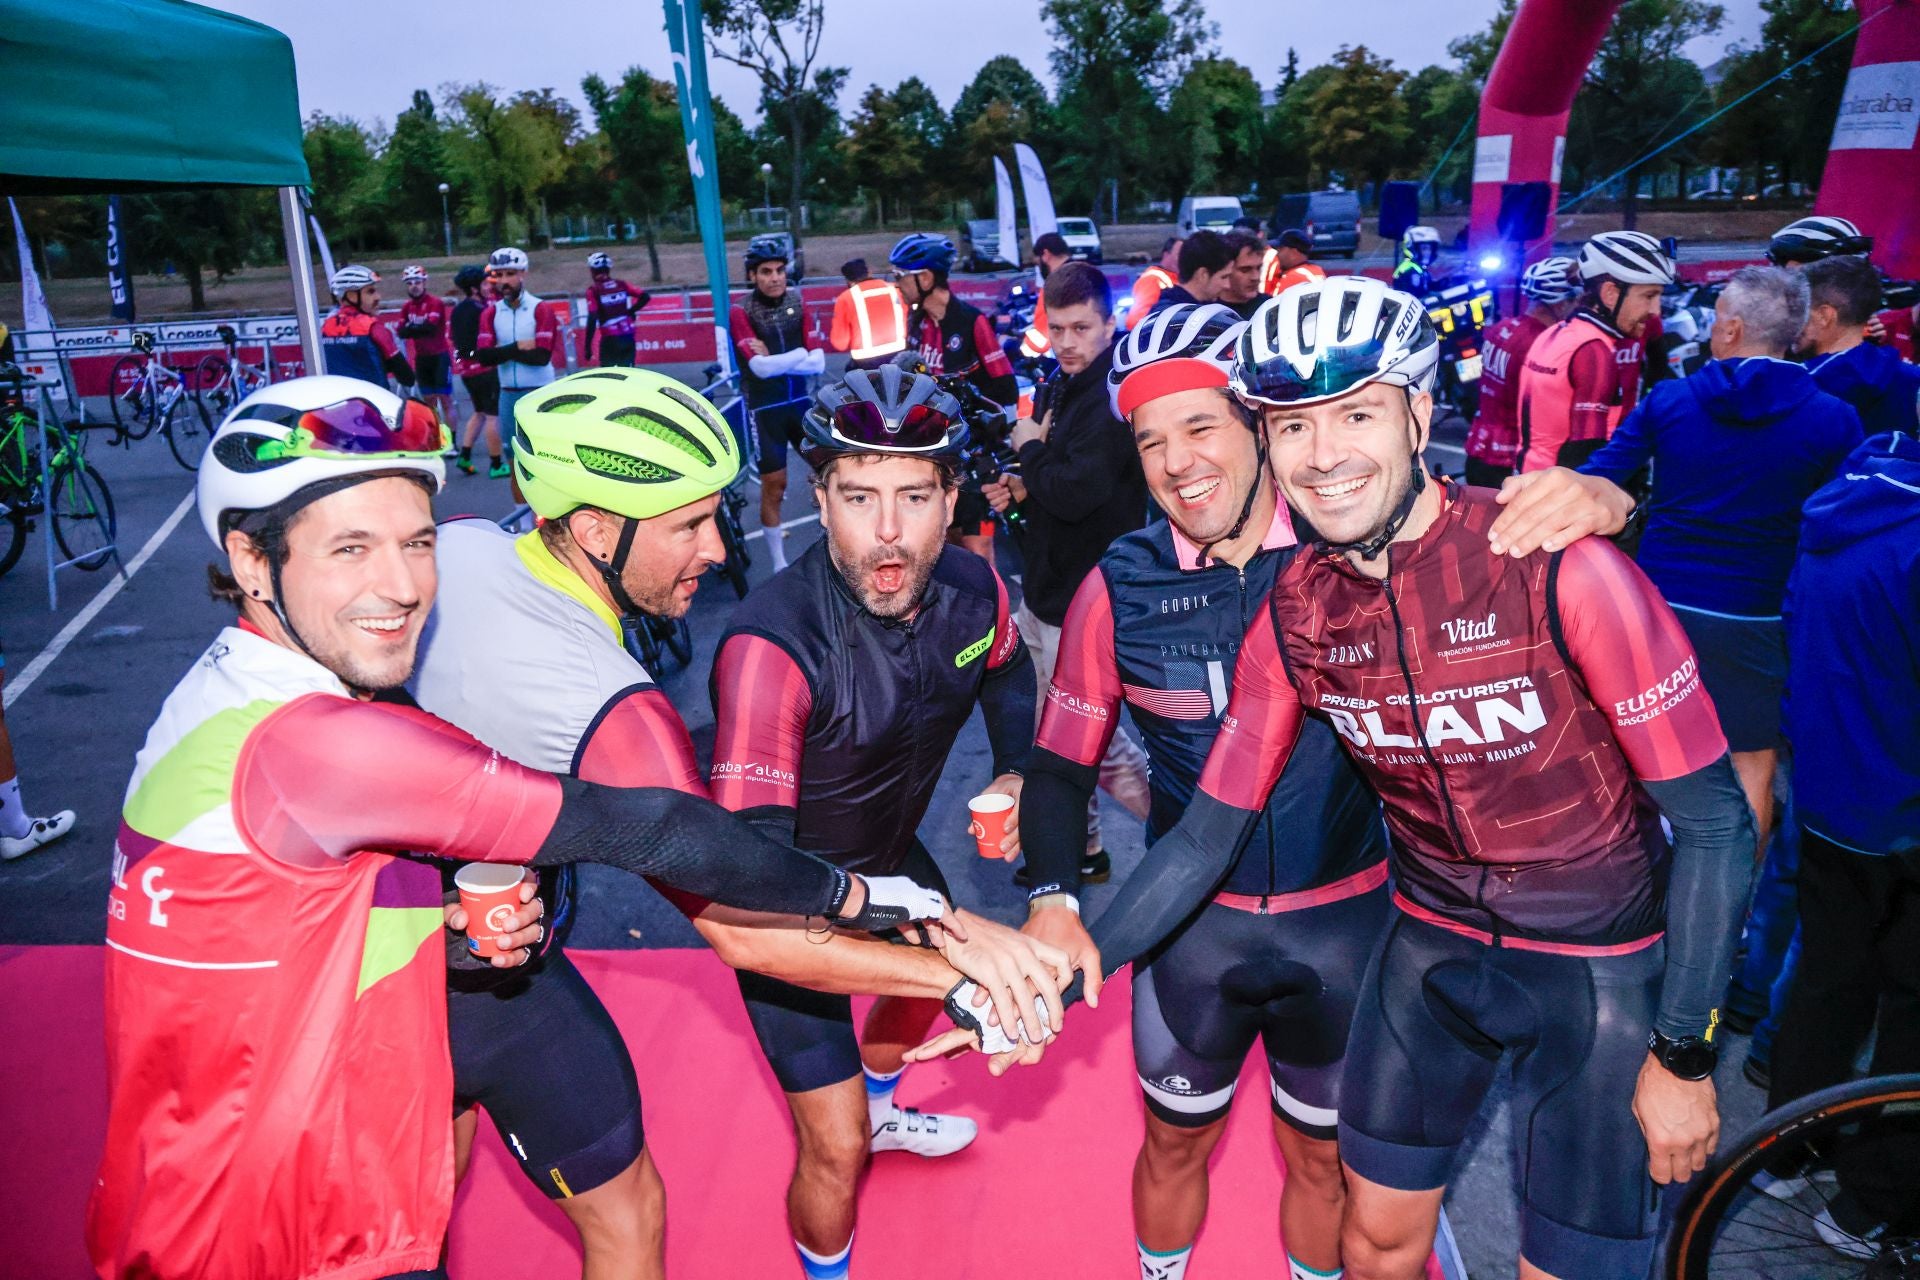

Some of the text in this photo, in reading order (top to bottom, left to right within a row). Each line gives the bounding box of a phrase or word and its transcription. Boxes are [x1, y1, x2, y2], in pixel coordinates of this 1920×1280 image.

[1396, 299, 1418, 342] SCOTT
[1161, 595, 1209, 614] GOBIK
[1441, 613, 1496, 644] Vital
[1160, 644, 1220, 657] PRUEBA
[1328, 643, 1374, 663] GOBIK
[1320, 675, 1534, 709] PRUEBA CICLOTURISTA
[1615, 654, 1696, 716] EUSKADI
[1319, 690, 1548, 748] BLAN
[1617, 707, 1661, 727] BASQUE
[1486, 741, 1537, 763] NAVARRA
